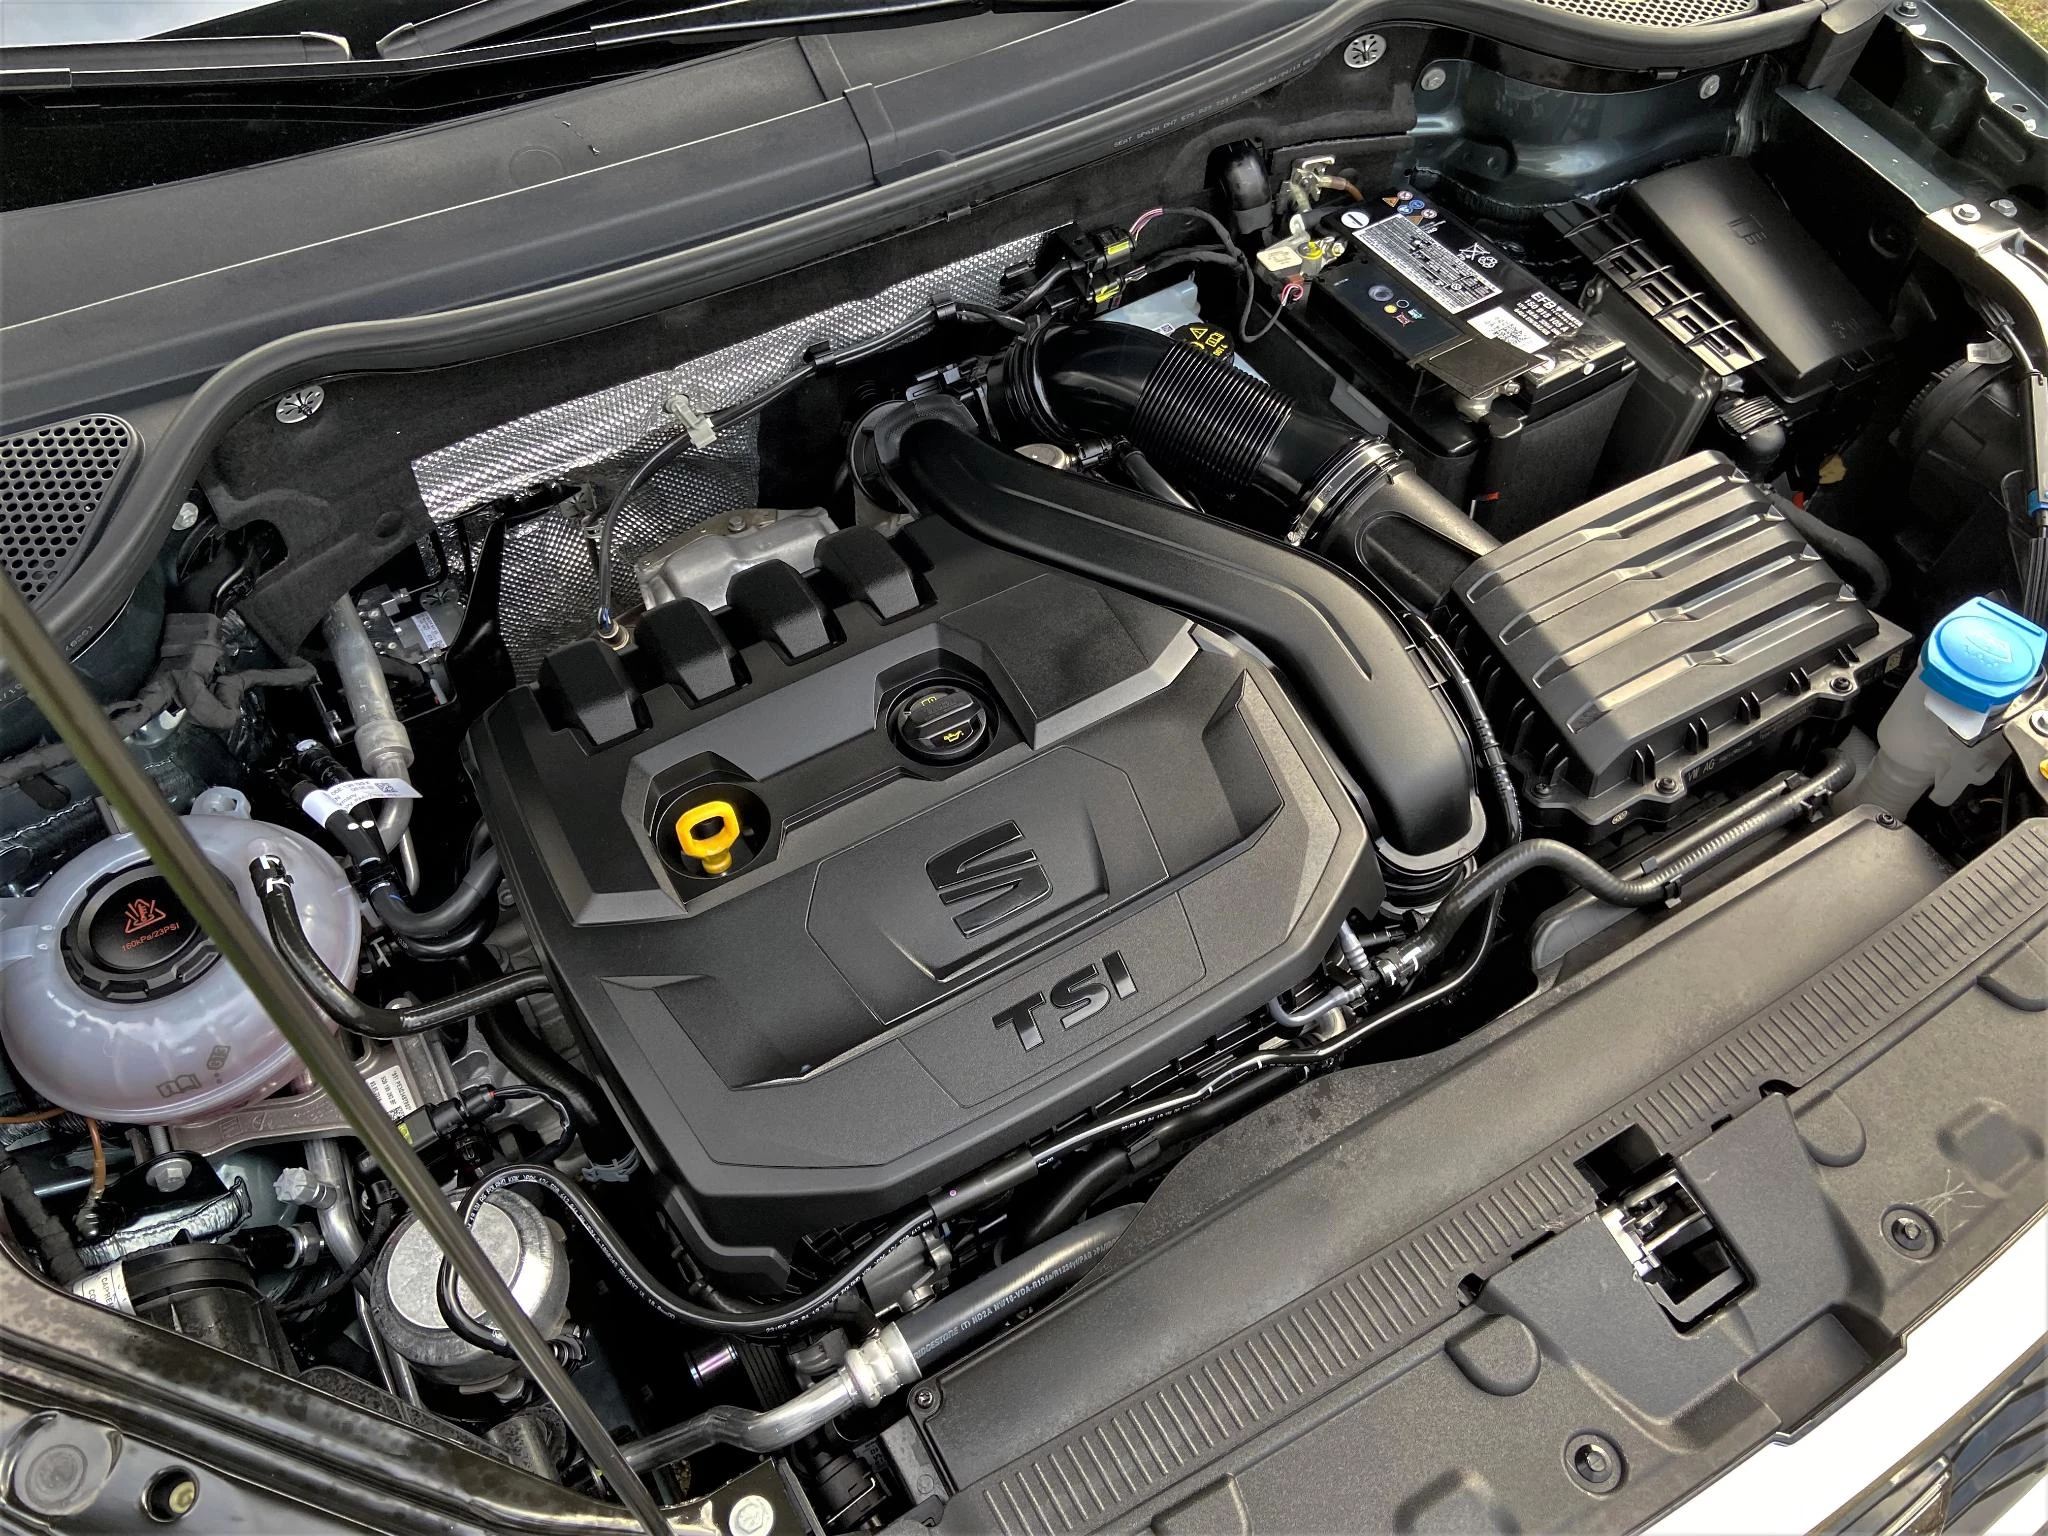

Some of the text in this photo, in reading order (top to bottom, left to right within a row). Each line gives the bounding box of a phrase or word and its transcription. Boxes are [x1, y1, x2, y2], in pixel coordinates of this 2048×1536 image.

[1114, 136, 1133, 147] SEAT
[1137, 126, 1160, 139] SPAIN
[1531, 291, 1557, 310] EFB
[121, 922, 180, 953] 160kPa/23PSI
[991, 949, 1139, 1053] TSI
[912, 1327, 959, 1360] RIDGESTONE
[961, 1320, 971, 1332] (T)
